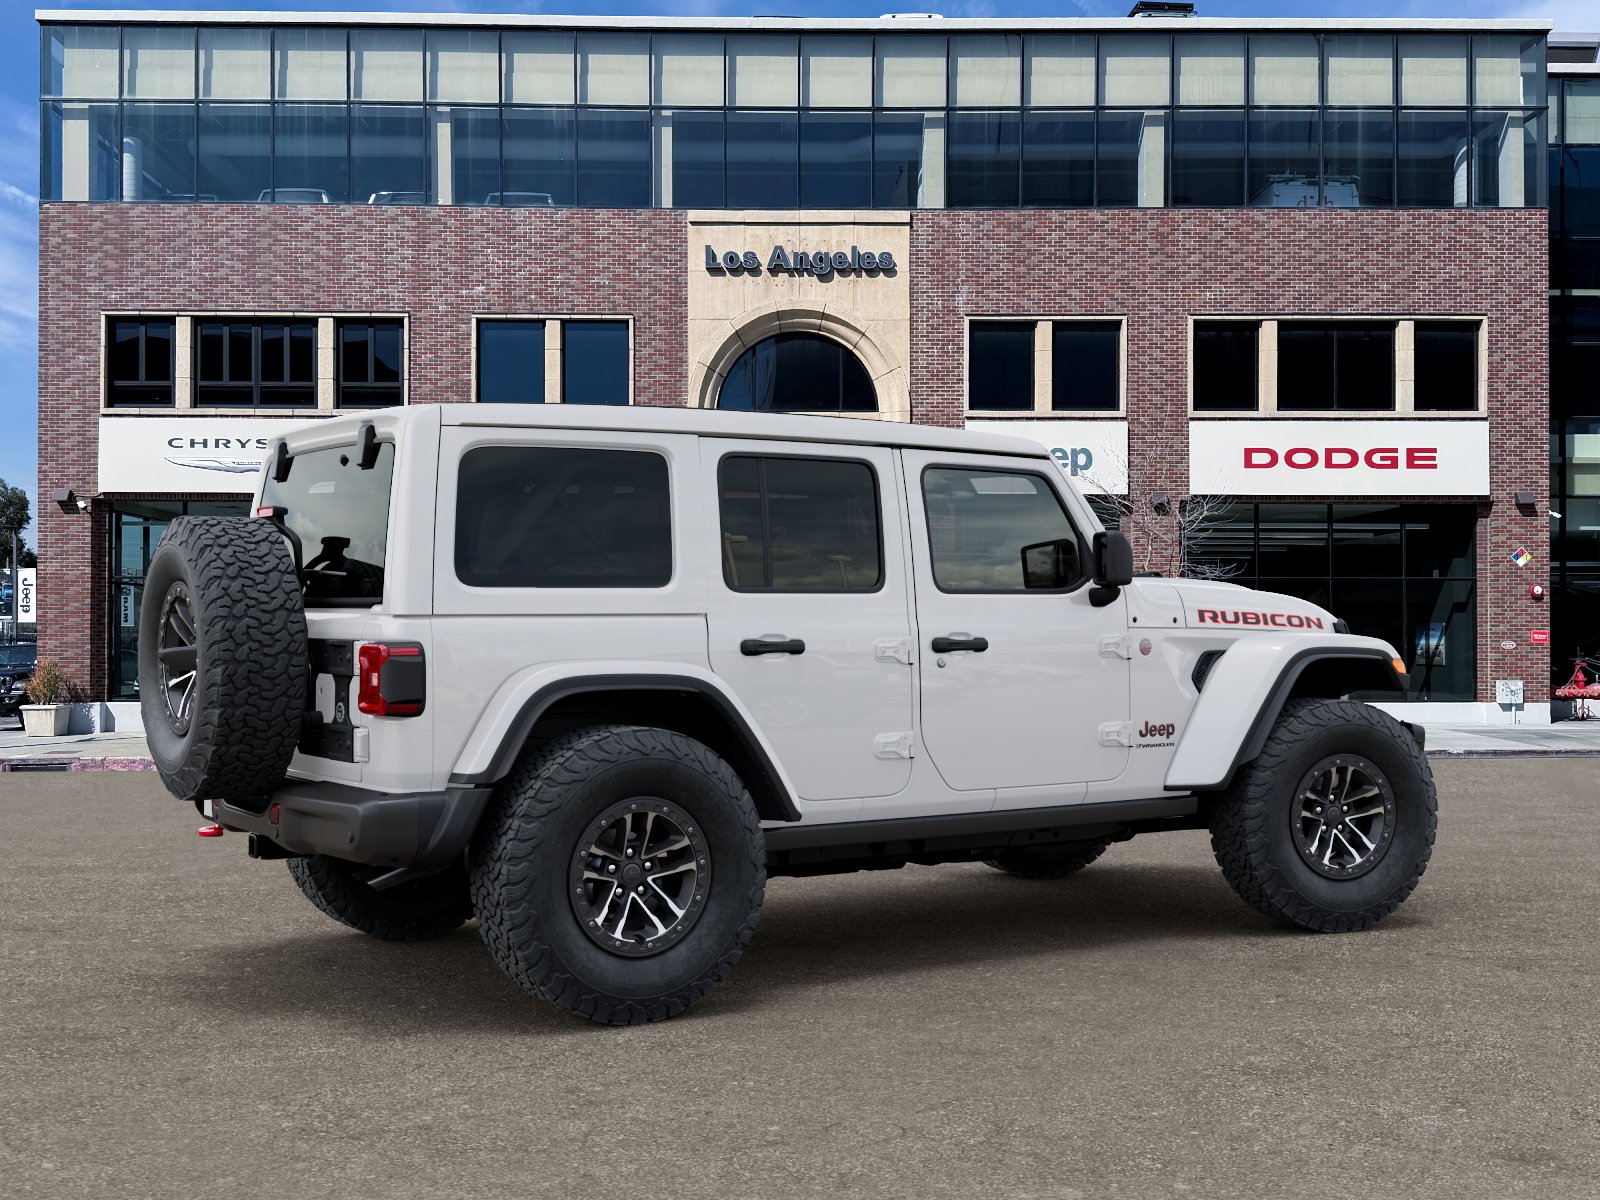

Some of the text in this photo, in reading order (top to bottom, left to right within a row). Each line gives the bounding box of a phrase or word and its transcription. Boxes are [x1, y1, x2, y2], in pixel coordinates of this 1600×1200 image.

[704, 244, 895, 275] Los Angeles
[167, 437, 268, 449] CHRYS
[1243, 447, 1438, 470] DODGE
[20, 577, 34, 614] Jeep
[1197, 609, 1325, 630] RUBICON
[1138, 720, 1176, 739] Jeep
